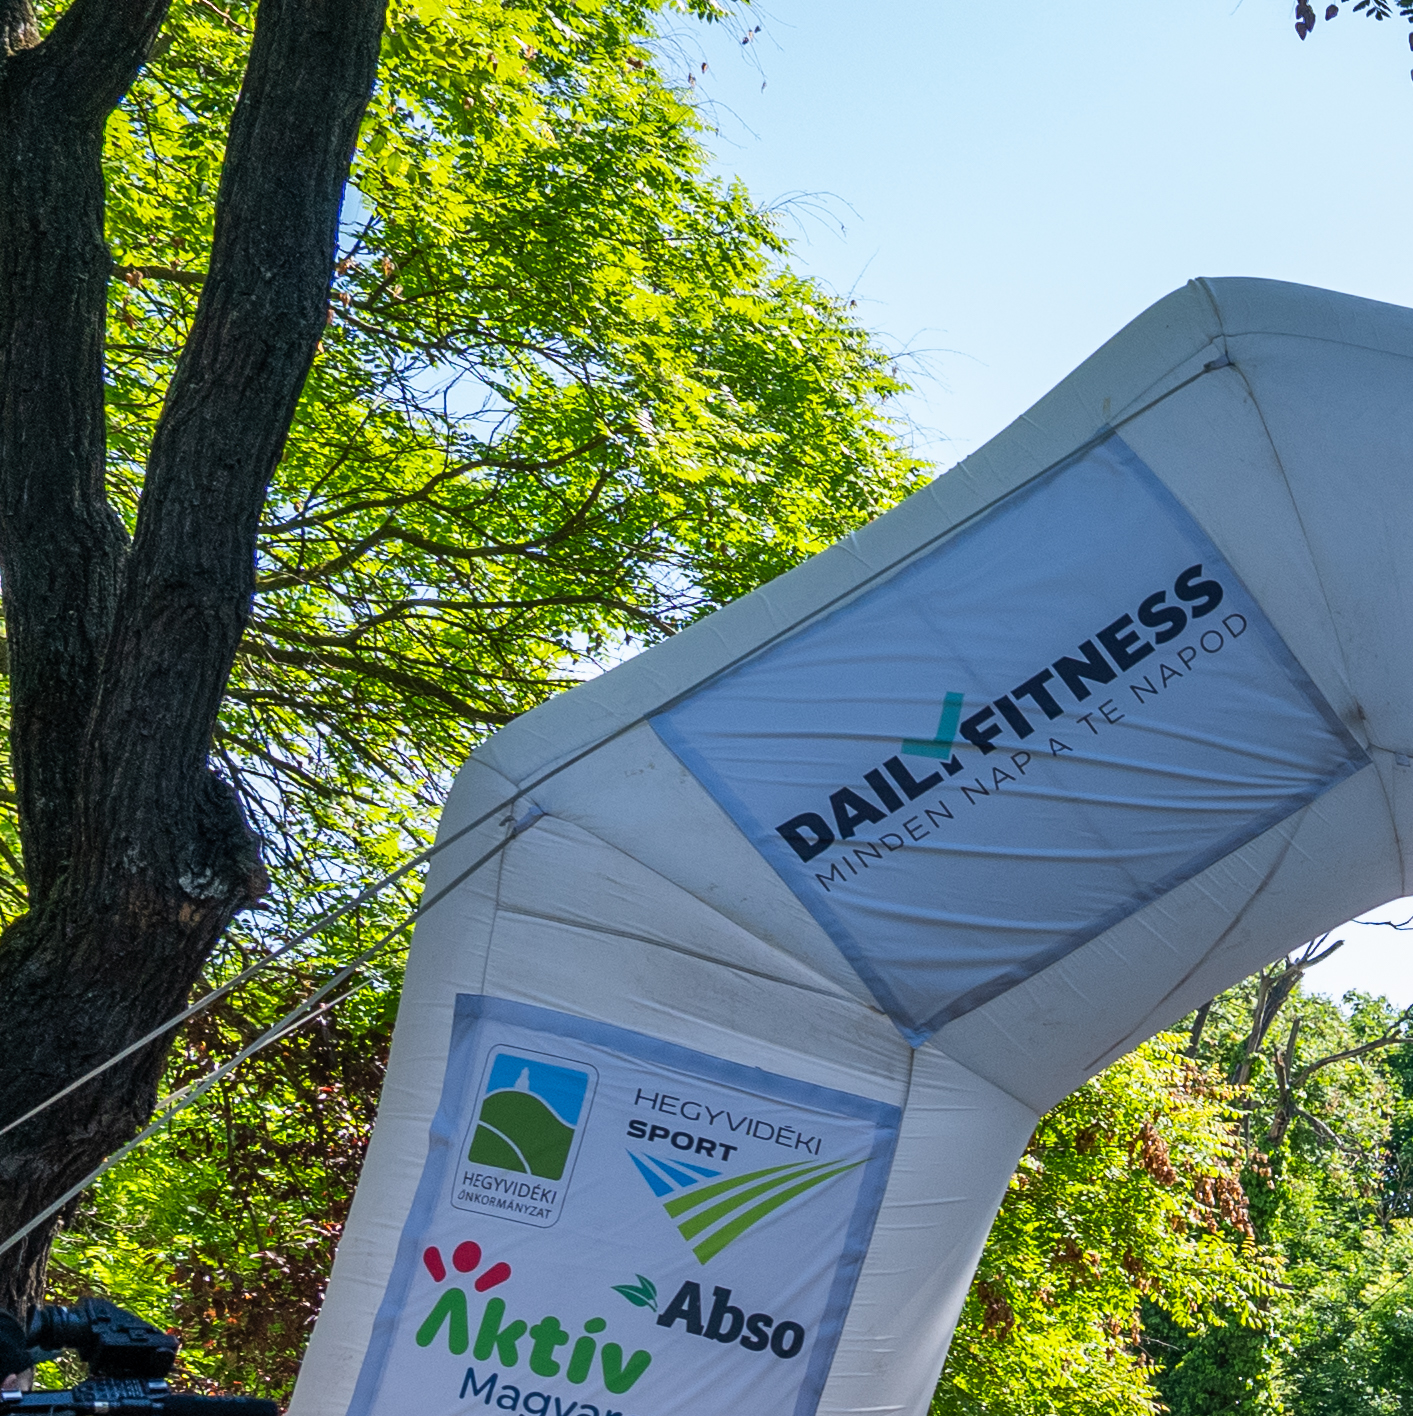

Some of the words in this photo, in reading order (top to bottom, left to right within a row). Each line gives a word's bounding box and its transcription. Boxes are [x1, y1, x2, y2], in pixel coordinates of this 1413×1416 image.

[958, 562, 1224, 756] FITNESS
[814, 800, 955, 893] MINDEN
[959, 750, 1032, 806] NAP
[1048, 736, 1074, 757] A
[1075, 698, 1127, 737] TE
[1129, 612, 1249, 705] NAPOD
[625, 1119, 738, 1162] SPORT
[633, 1087, 822, 1156] HEGYVIDÉKI
[456, 1189, 553, 1220] ÖNKORMÁNYZAT
[462, 1170, 558, 1206] HEGYVIDÉKI
[655, 1279, 806, 1360] Abso
